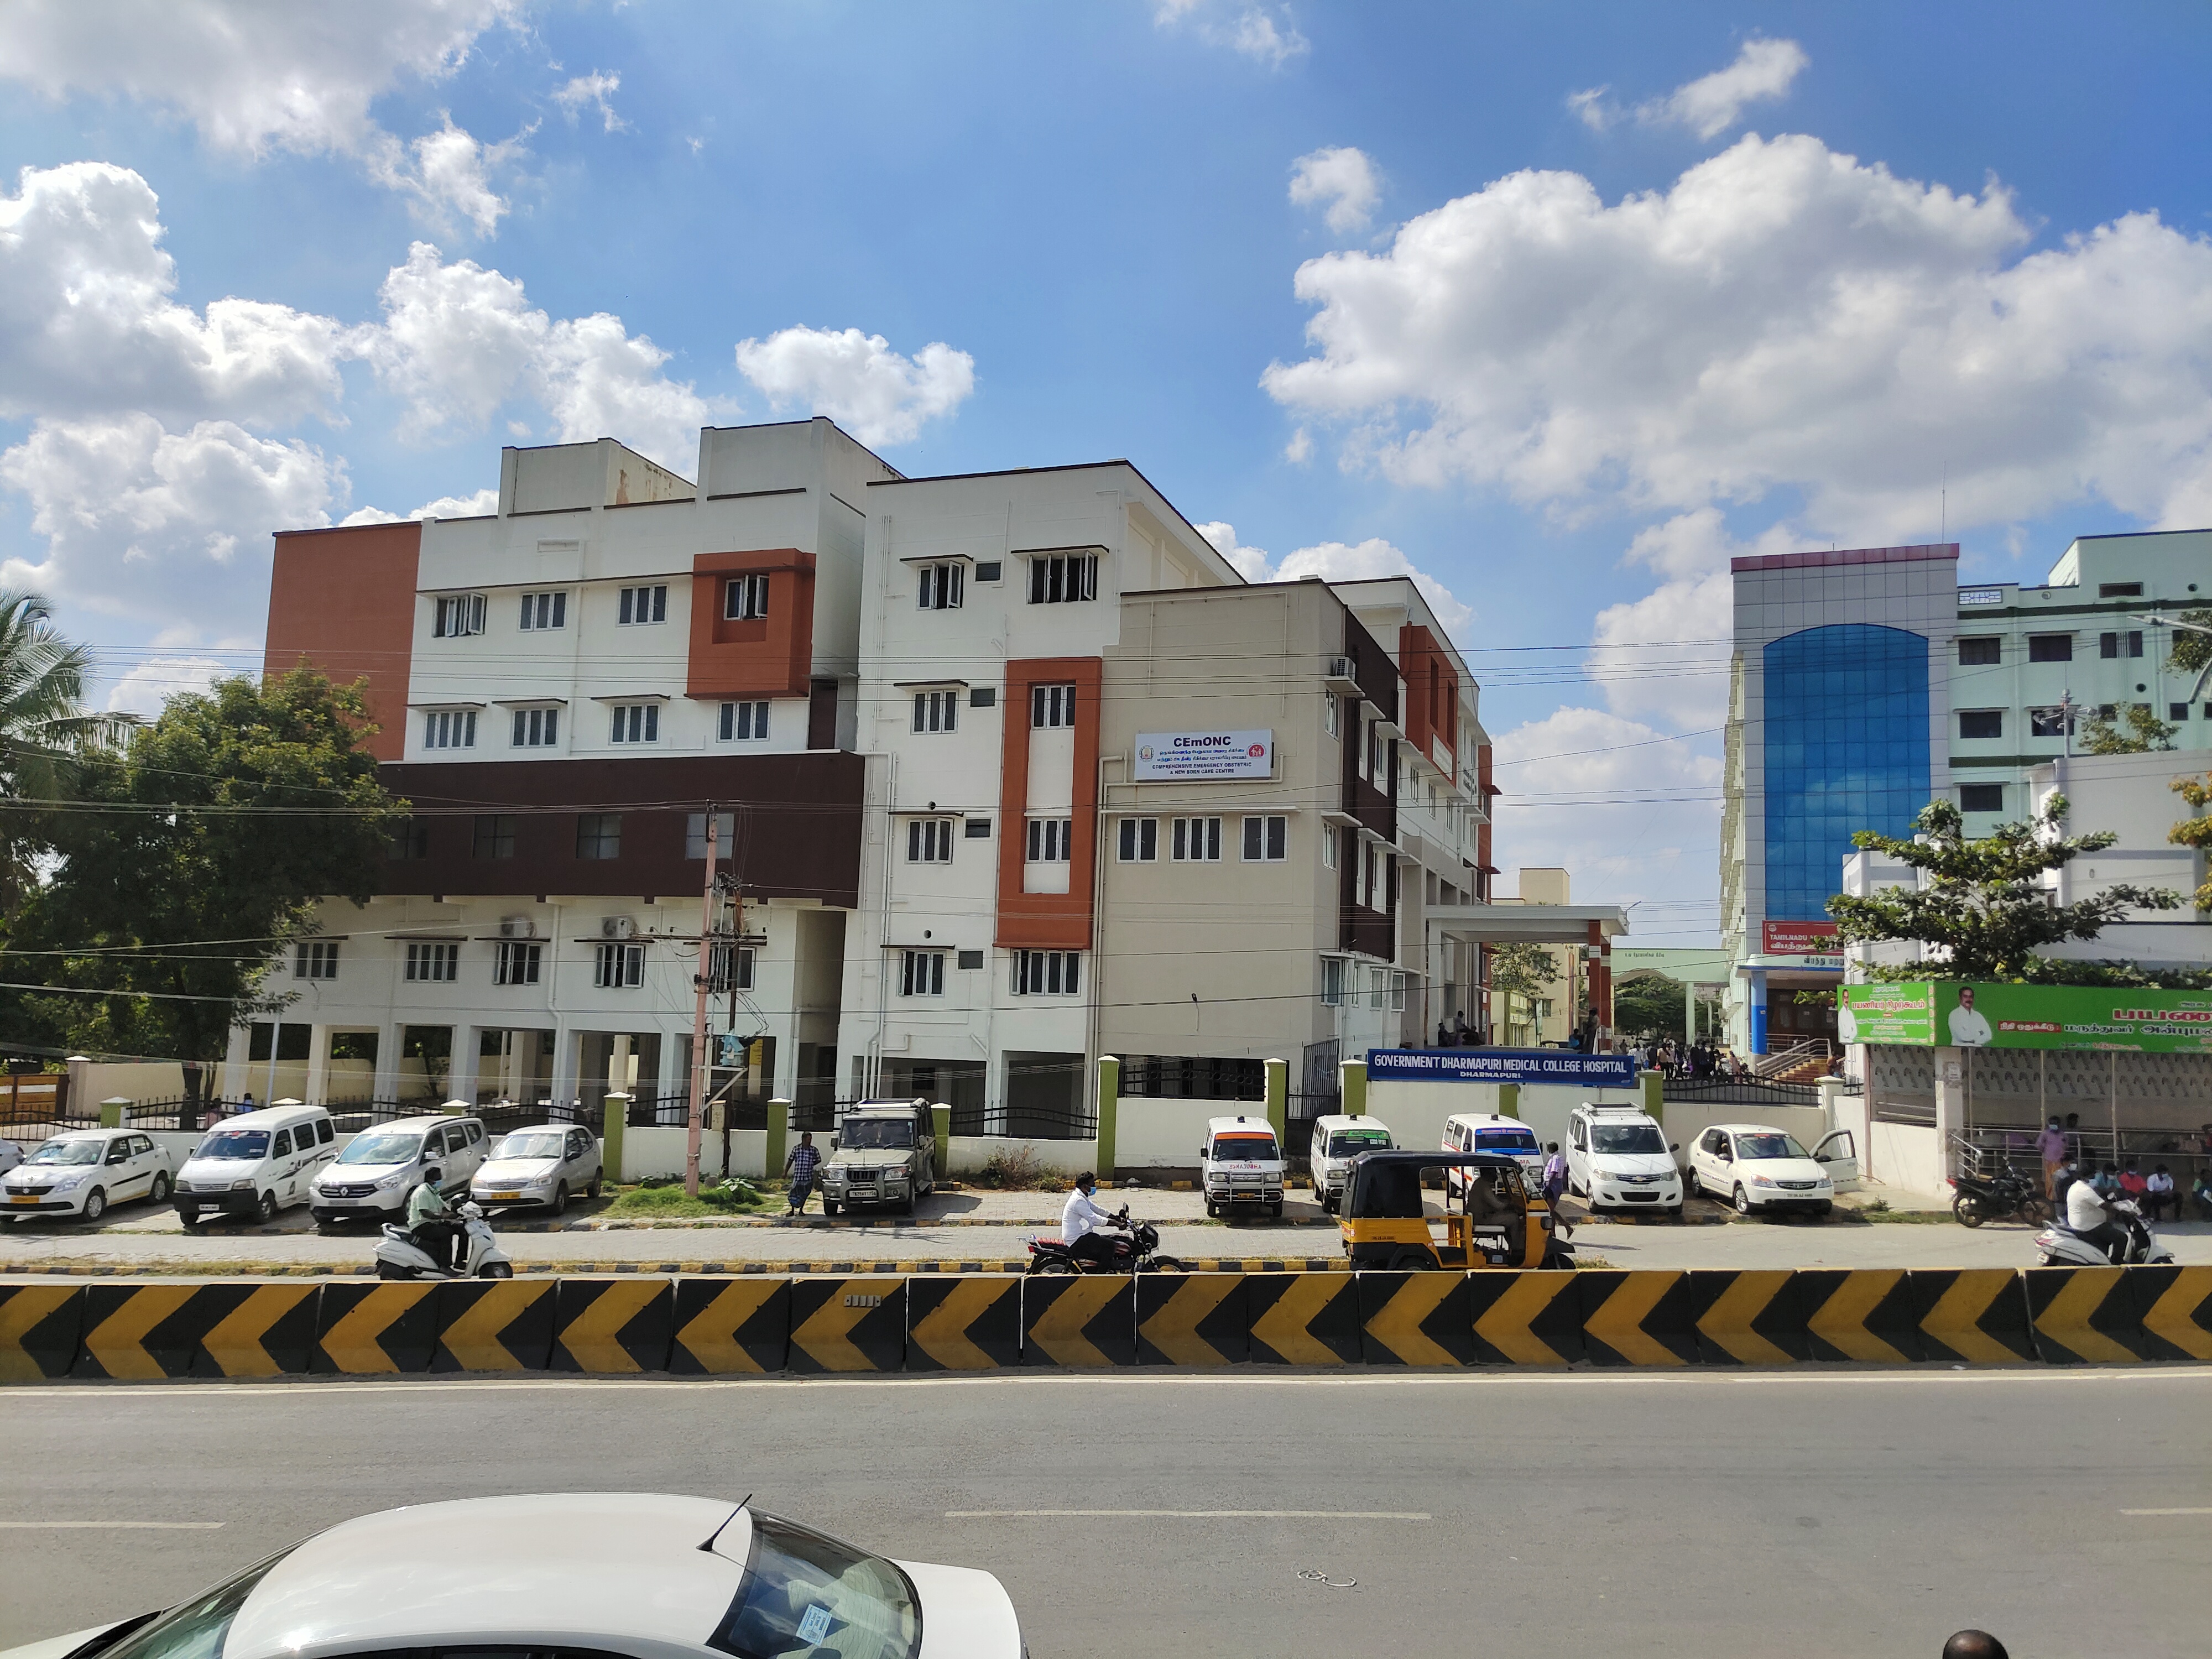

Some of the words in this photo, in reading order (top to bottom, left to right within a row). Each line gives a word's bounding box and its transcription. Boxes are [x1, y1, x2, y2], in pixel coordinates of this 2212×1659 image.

[1173, 736, 1232, 747] CEmONC
[1852, 999, 1885, 1010] பயணியர்
[2064, 1023, 2134, 1034] மருத்துவர்
[1374, 1055, 1440, 1068] GOVERNMENT
[1441, 1057, 1501, 1070] DHARMAPURI
[1503, 1059, 1541, 1071] MEDICAL
[1543, 1060, 1581, 1072] COLLEGE
[1583, 1061, 1627, 1073] HOSPITAL
